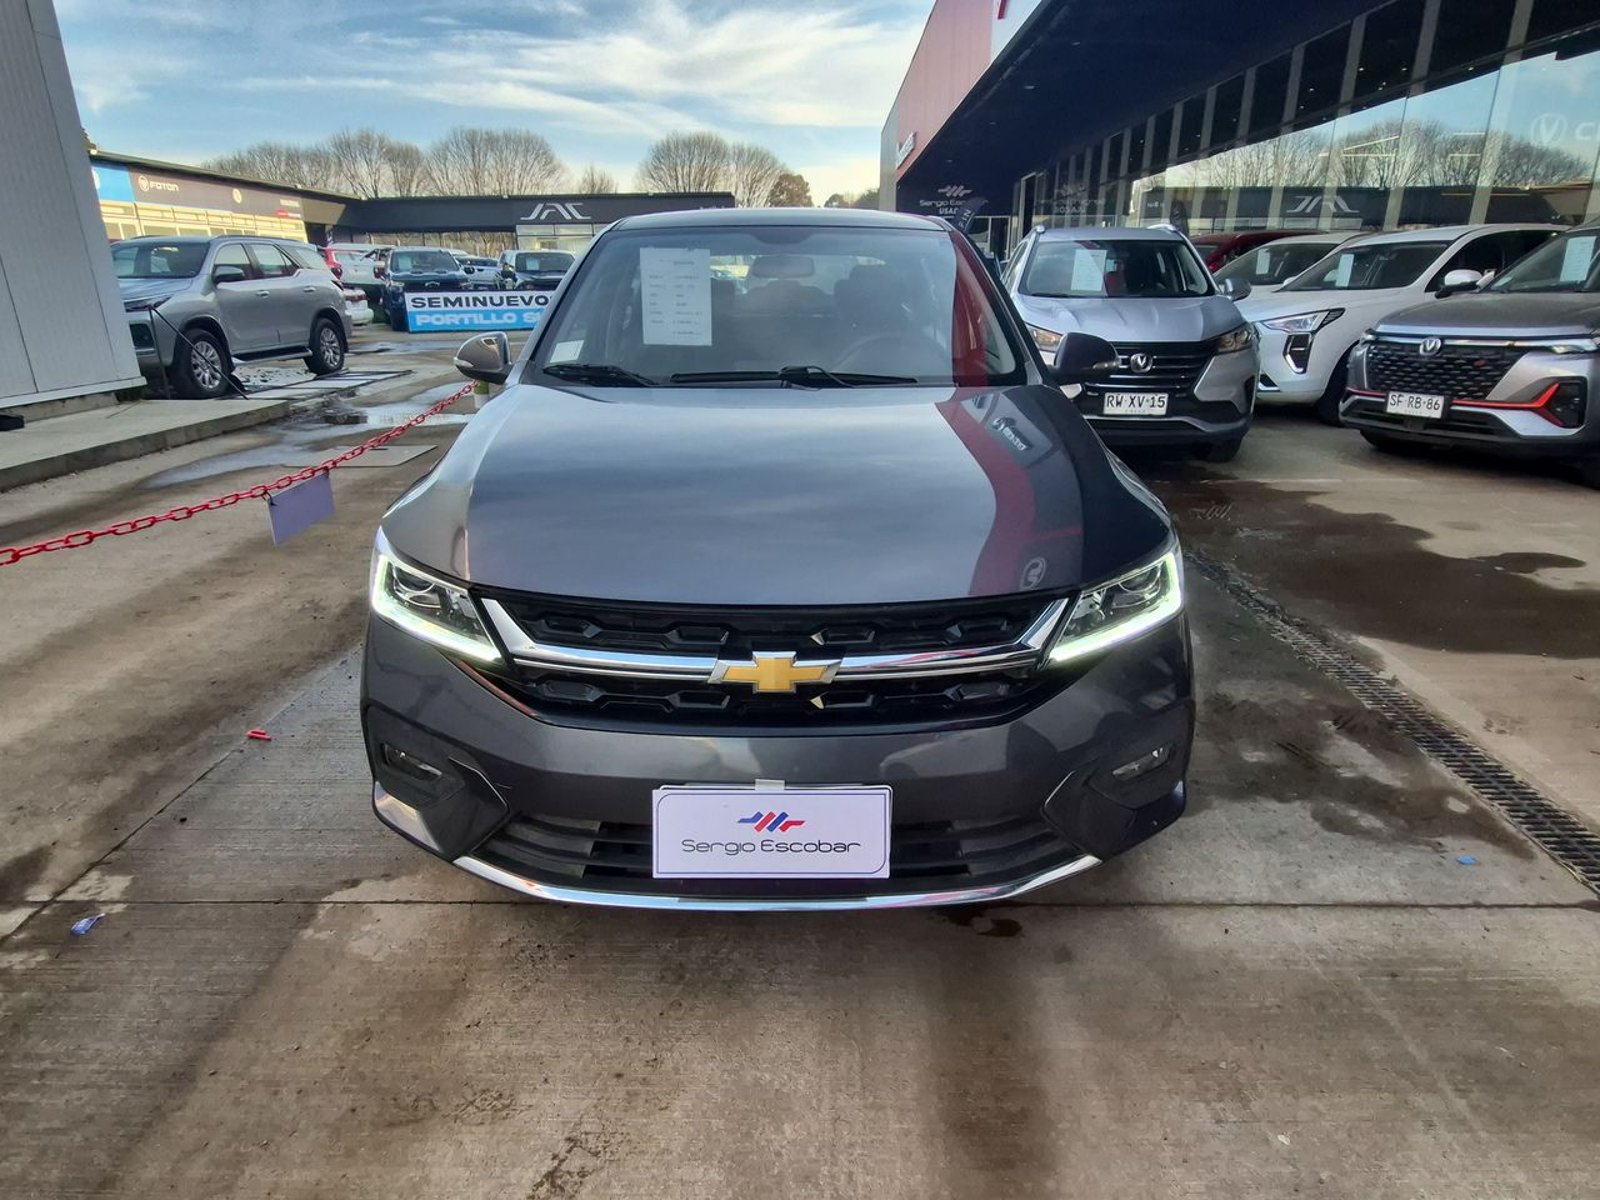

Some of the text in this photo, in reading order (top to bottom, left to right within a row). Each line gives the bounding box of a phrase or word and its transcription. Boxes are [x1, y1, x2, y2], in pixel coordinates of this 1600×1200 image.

[150, 181, 180, 191] FOTON
[520, 203, 592, 220] JAC
[411, 295, 552, 309] SEMINUEVO
[415, 312, 517, 326] PORTILLO
[681, 839, 861, 855] Sergio Escobar
